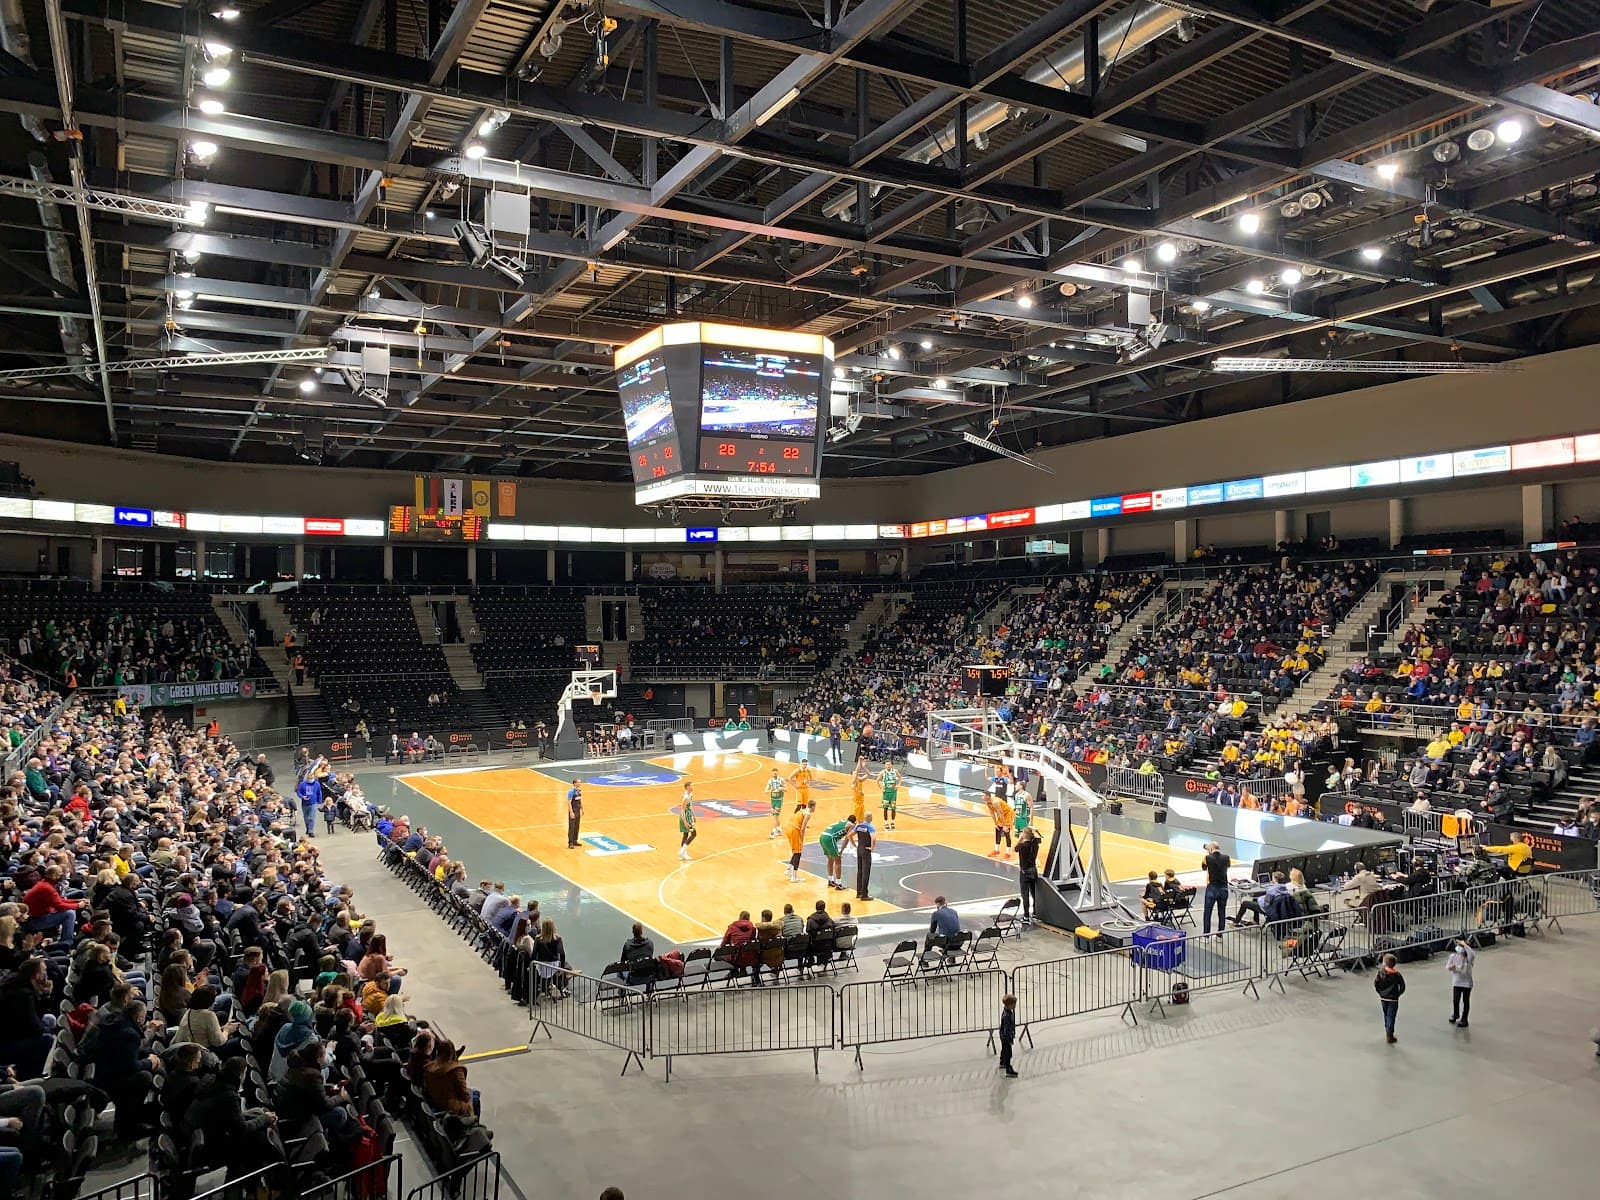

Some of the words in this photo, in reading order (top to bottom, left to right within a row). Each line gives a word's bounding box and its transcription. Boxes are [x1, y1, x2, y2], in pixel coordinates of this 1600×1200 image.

[719, 443, 736, 456] 26
[783, 447, 800, 459] 22
[747, 461, 776, 473] 7:54
[169, 684, 194, 698] GREEN
[194, 682, 219, 696] WHITE
[219, 681, 239, 694] BOYS
